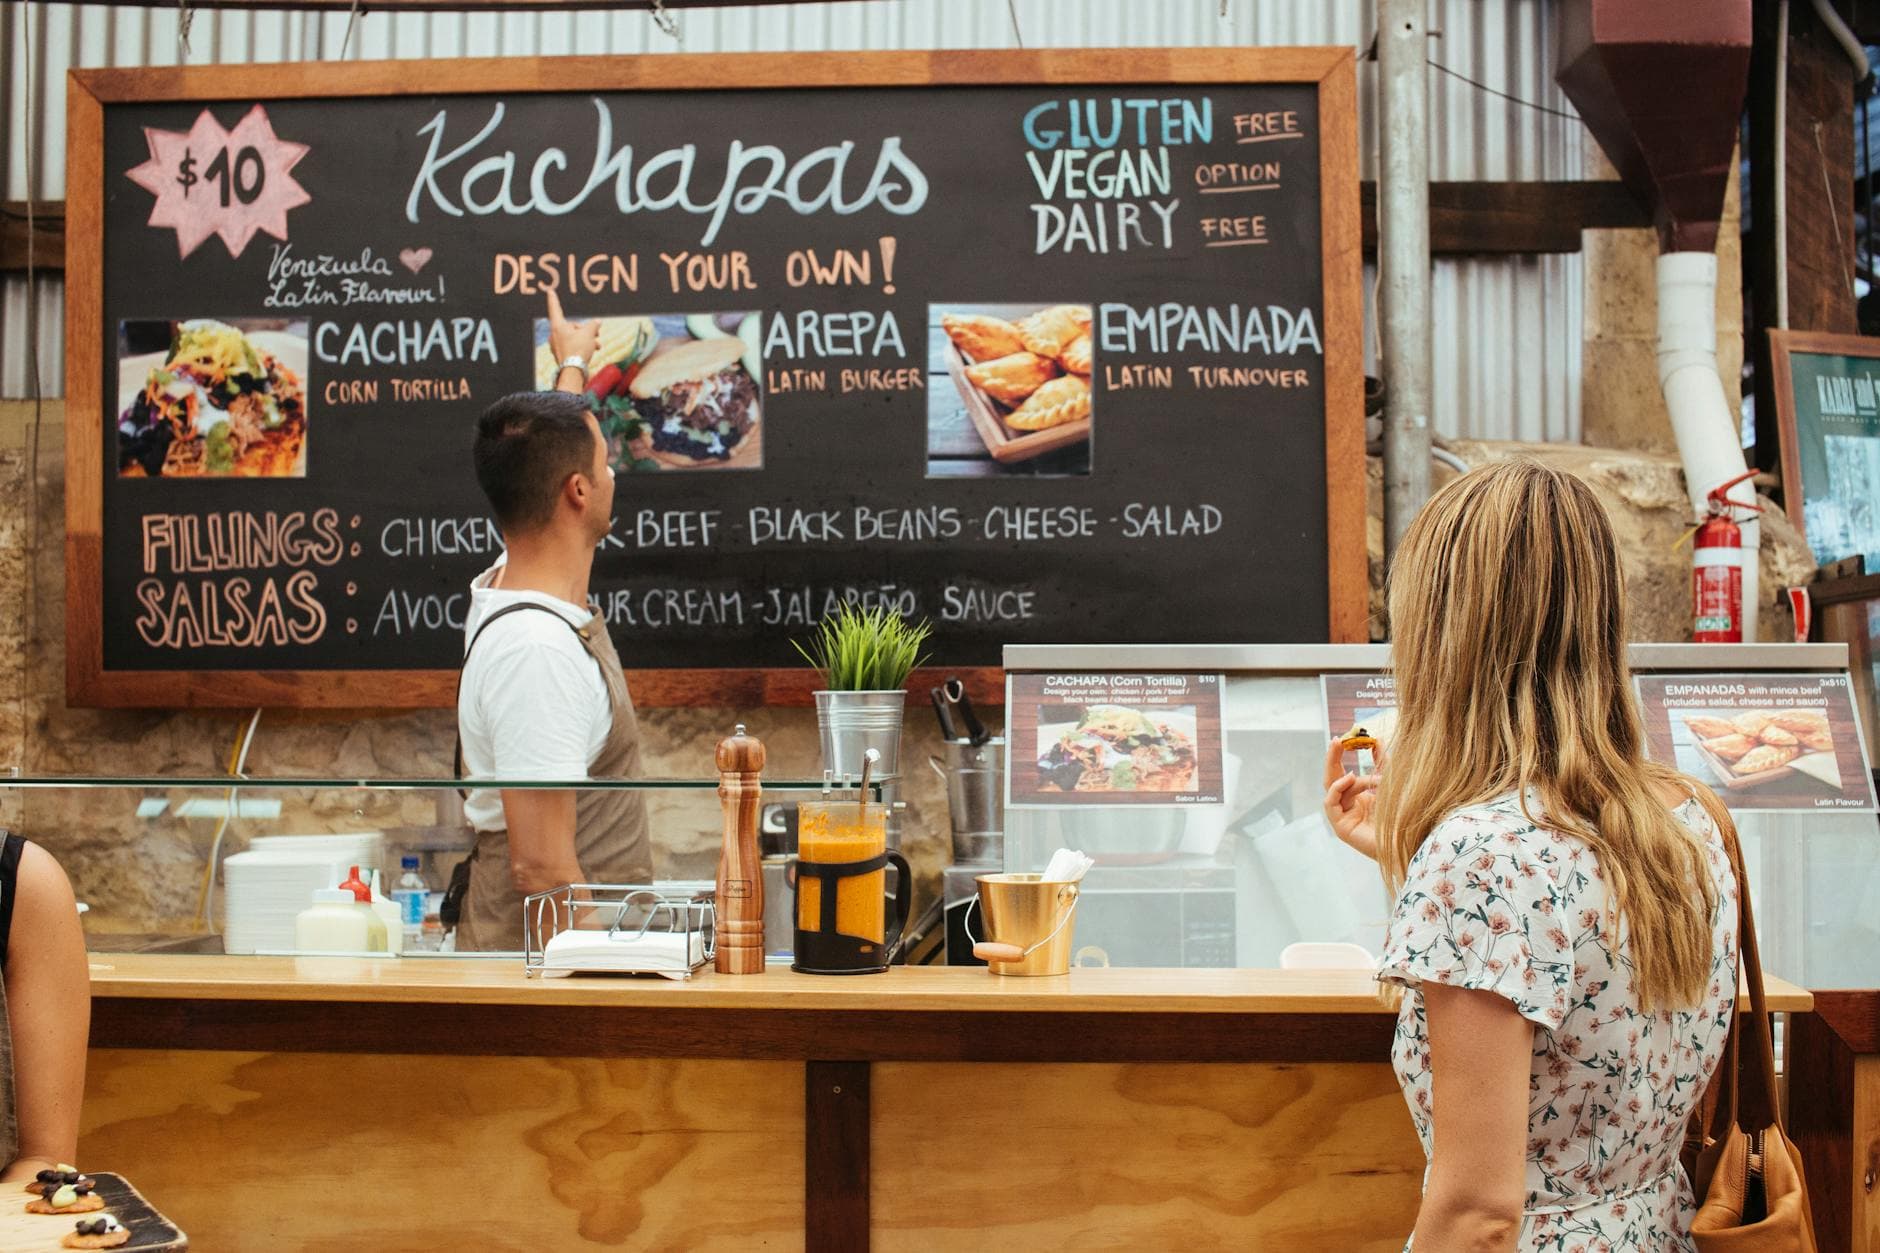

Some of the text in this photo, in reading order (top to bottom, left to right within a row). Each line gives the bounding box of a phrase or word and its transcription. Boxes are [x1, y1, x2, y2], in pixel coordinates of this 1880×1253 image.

[1023, 97, 1300, 150] GLUTEN FREE
[176, 146, 266, 207] $10
[406, 98, 929, 247] Kachapas
[1025, 146, 1280, 200] VEGAN OPTION
[1030, 199, 1266, 255] DAIRY FREE
[267, 243, 393, 281] Venezuela
[494, 236, 897, 294] DESIGN YOUR OWN!
[264, 278, 338, 308] Latin
[315, 317, 498, 366] CACHAPA
[763, 310, 905, 359] AREPA
[1100, 302, 1322, 355] EMPANADA
[325, 380, 378, 405] CORN
[840, 367, 924, 393] BURGER
[1189, 366, 1310, 389] TURNOVER
[749, 506, 844, 545] BLACK
[855, 505, 961, 541] BEANS
[984, 506, 1097, 540] CHEESE
[373, 589, 465, 635] AVOC
[941, 585, 1036, 621] SAUCE
[1043, 688, 1070, 696] Design
[1111, 687, 1140, 695] chicken
[1146, 688, 1162, 696] pork
[1167, 687, 1185, 695] beef
[1046, 675, 1187, 688] CACHAPA (Corn Tortilla)
[1199, 675, 1215, 684] $10
[1366, 678, 1394, 689] ARE
[1664, 684, 1822, 695] EMPANADAS with mince beef
[1820, 679, 1846, 687] 3x$10
[1356, 691, 1383, 699] Design
[1662, 697, 1706, 708] (includes
[1739, 697, 1773, 705] cheese
[1775, 697, 1793, 705] and
[1795, 697, 1828, 707] sauce)
[1814, 798, 1864, 806] Latin Flavour
